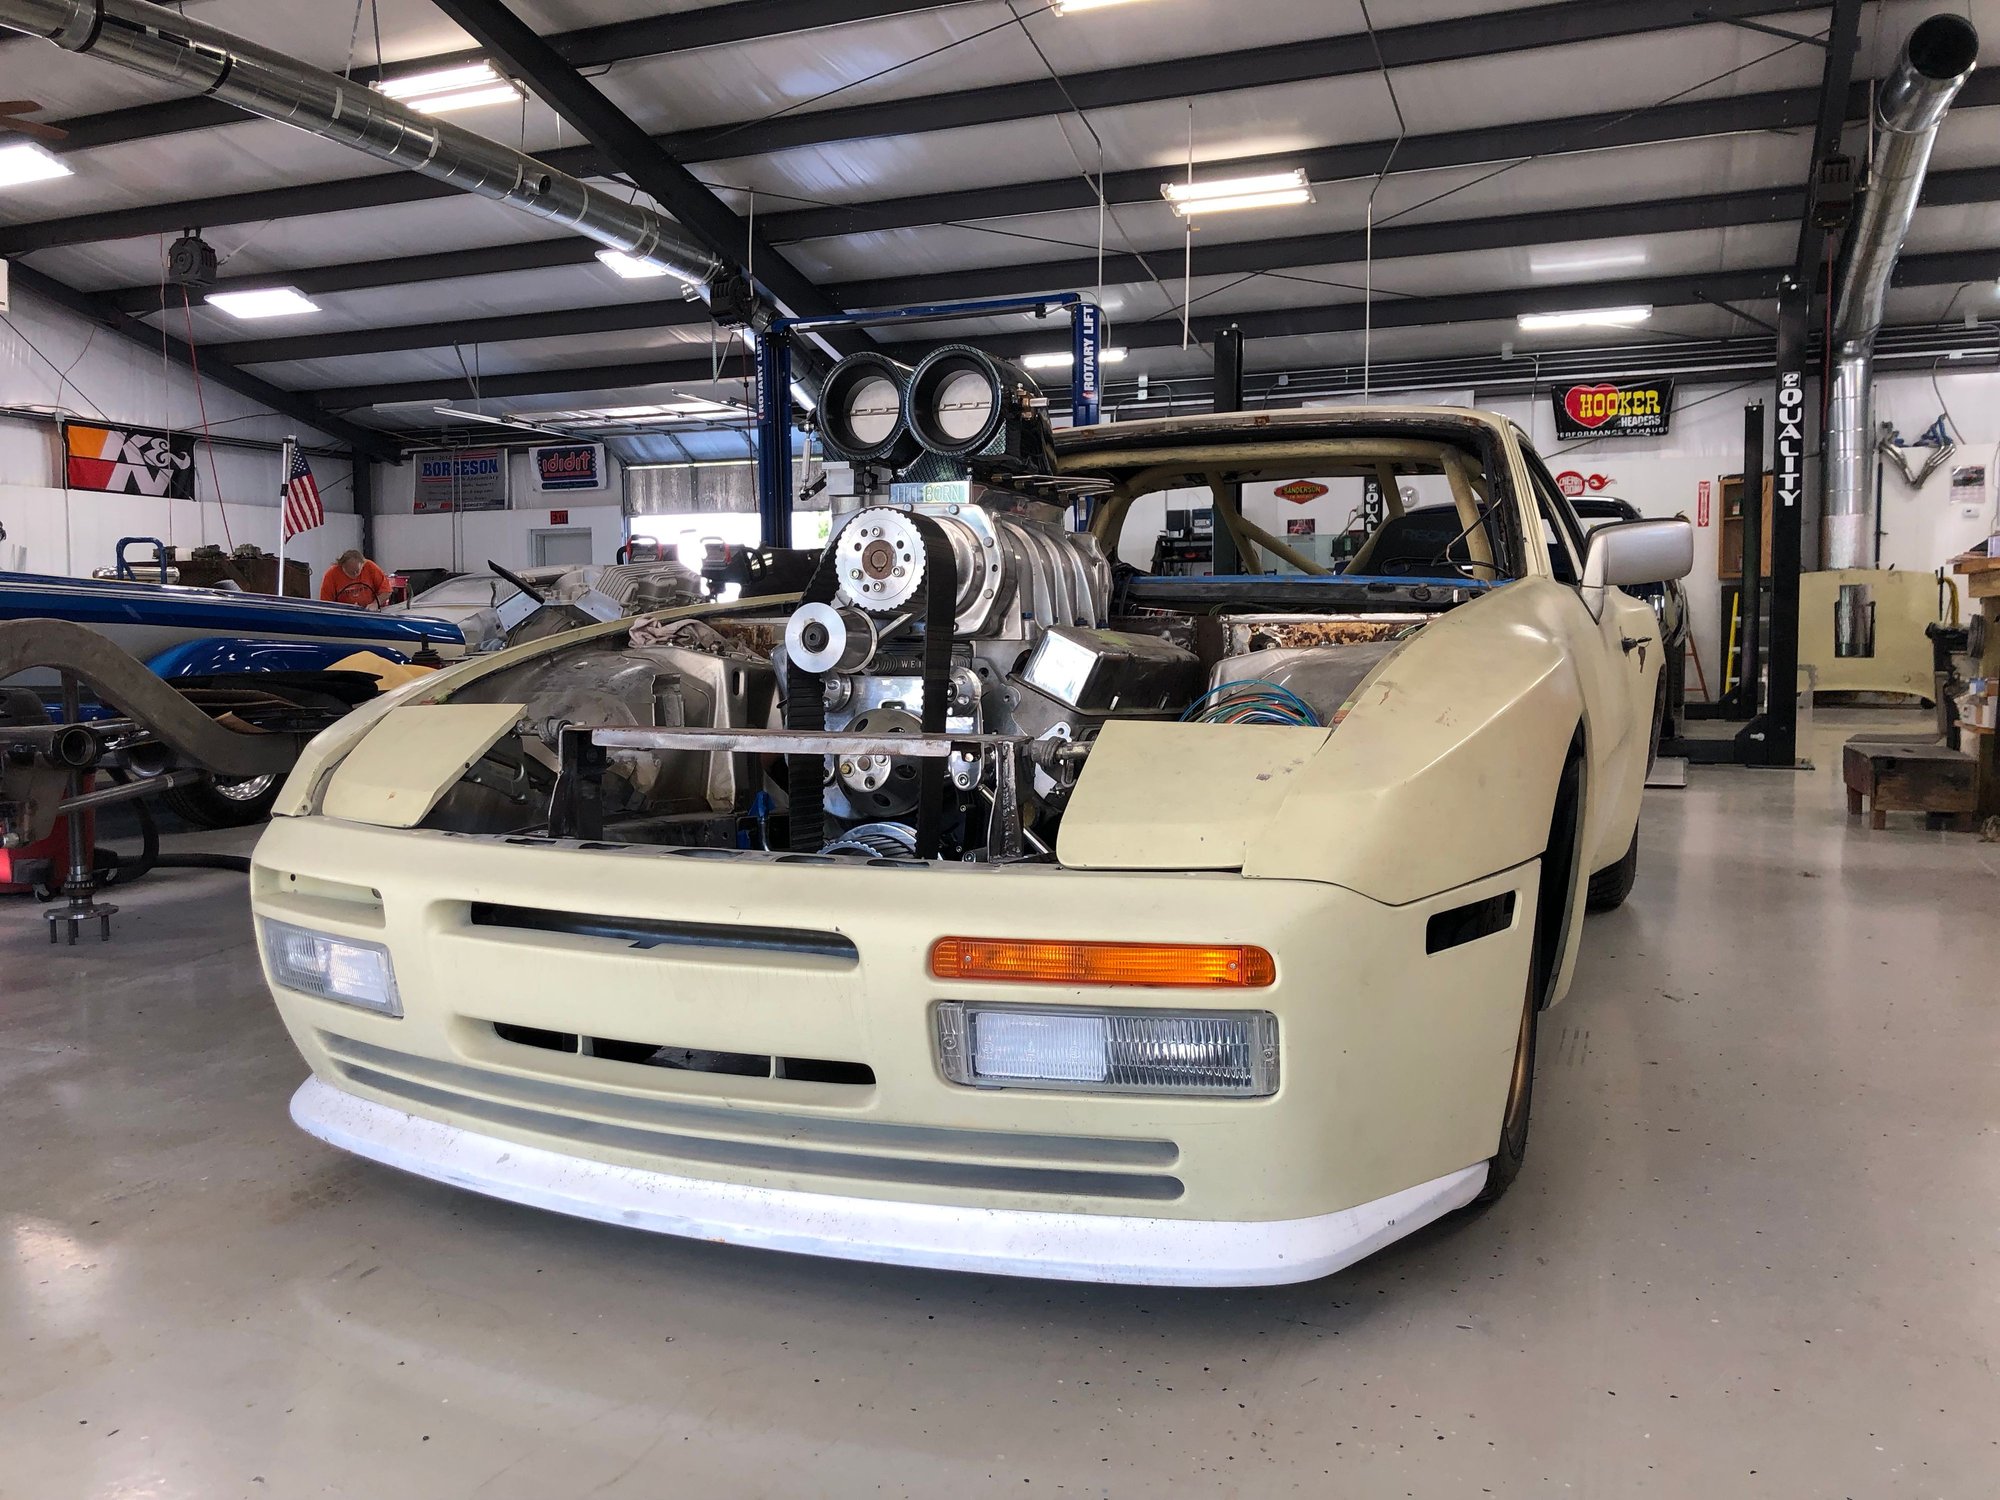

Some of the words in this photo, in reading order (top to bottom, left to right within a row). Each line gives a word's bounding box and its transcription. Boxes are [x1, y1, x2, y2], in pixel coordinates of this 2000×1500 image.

[1083, 306, 1094, 335] LIFT
[1083, 338, 1094, 391] ROTARY
[1580, 389, 1661, 418] HOOKER
[1621, 415, 1661, 428] HEADERS
[422, 460, 499, 476] BORGESON
[542, 451, 590, 472] ididit
[551, 511, 567, 524] EXIT
